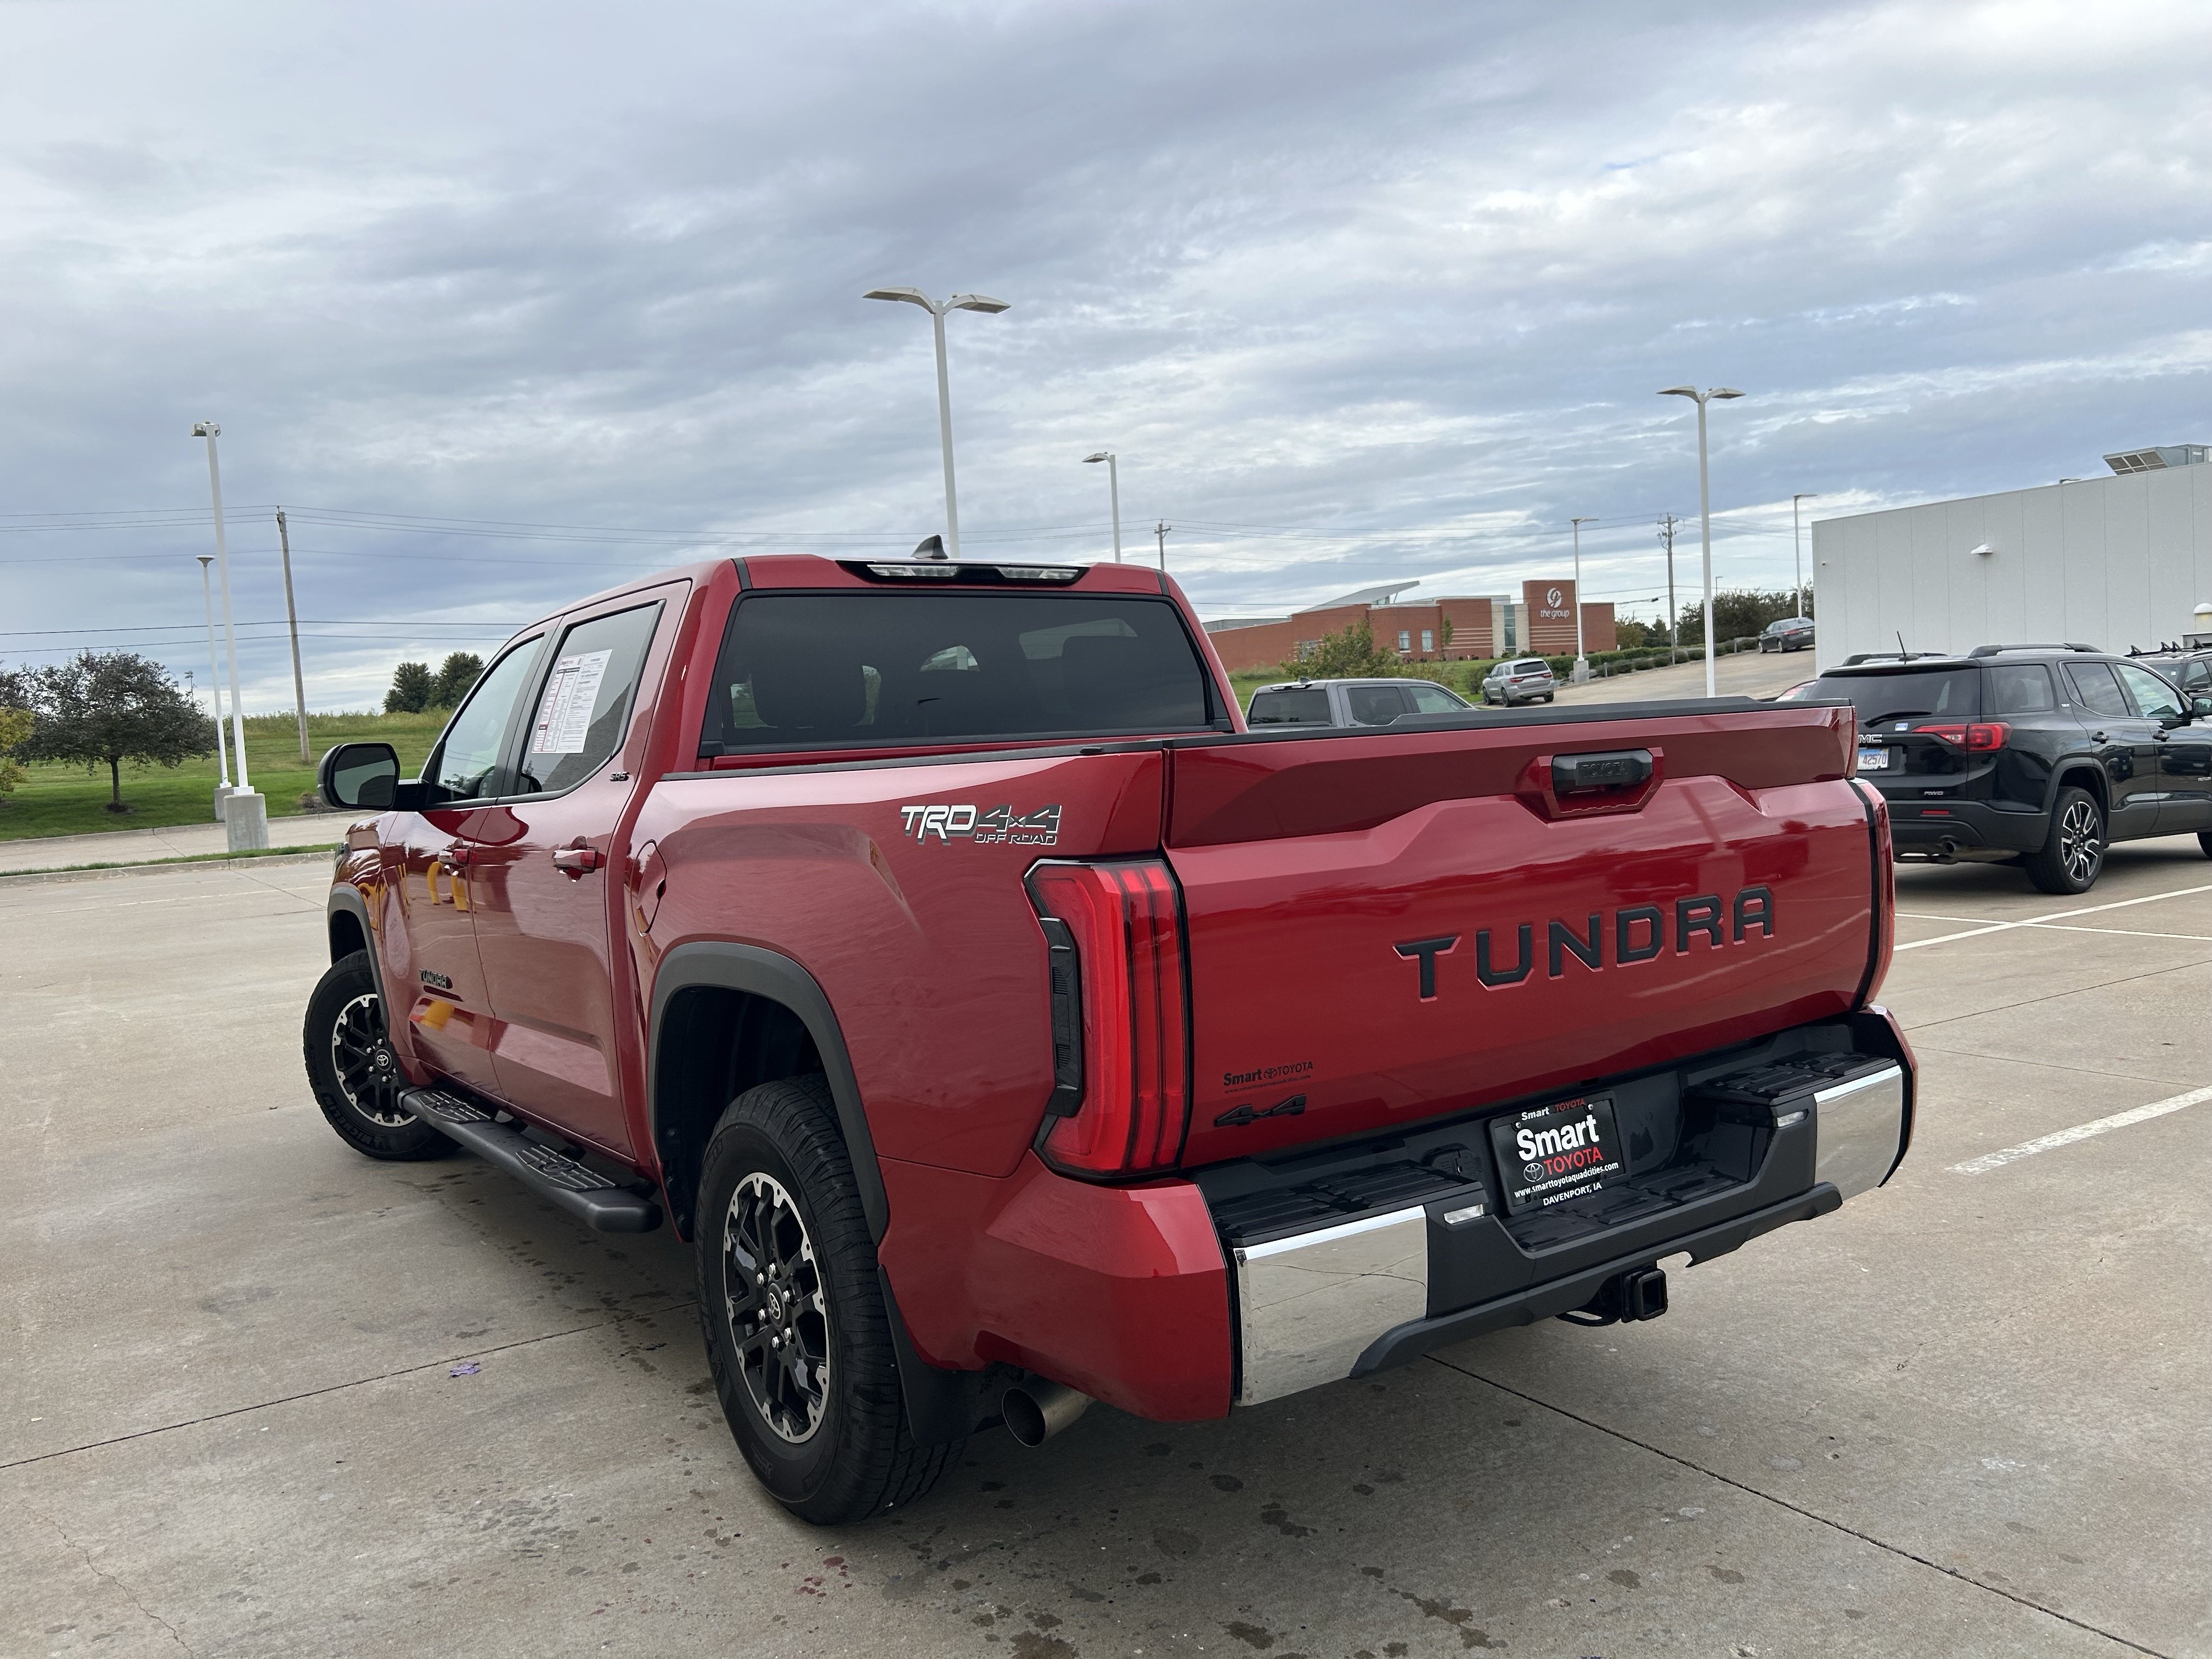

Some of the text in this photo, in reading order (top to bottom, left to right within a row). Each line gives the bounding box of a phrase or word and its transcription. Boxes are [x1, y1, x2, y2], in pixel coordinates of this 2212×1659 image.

[1540, 609, 1570, 620] the group
[1858, 733, 1882, 743] MC
[1582, 761, 1628, 778] TOYOTA
[1863, 754, 1887, 765] 42570
[610, 771, 629, 781] SR5
[900, 804, 979, 845] TRD
[974, 833, 1058, 845] OFF ROAD
[1392, 885, 1774, 1002] TUNDRA
[419, 968, 448, 989] TUNDRA
[1223, 1062, 1313, 1086] Smart TOYOTA
[1521, 1098, 1585, 1121] Smart TOYOTA
[1516, 1114, 1600, 1161] Smart
[1543, 1146, 1604, 1176] TOYOTA
[1514, 1161, 1619, 1198] www.smarttoyotaquadcities.com
[1543, 1182, 1602, 1206] DAVENPORT, IA
